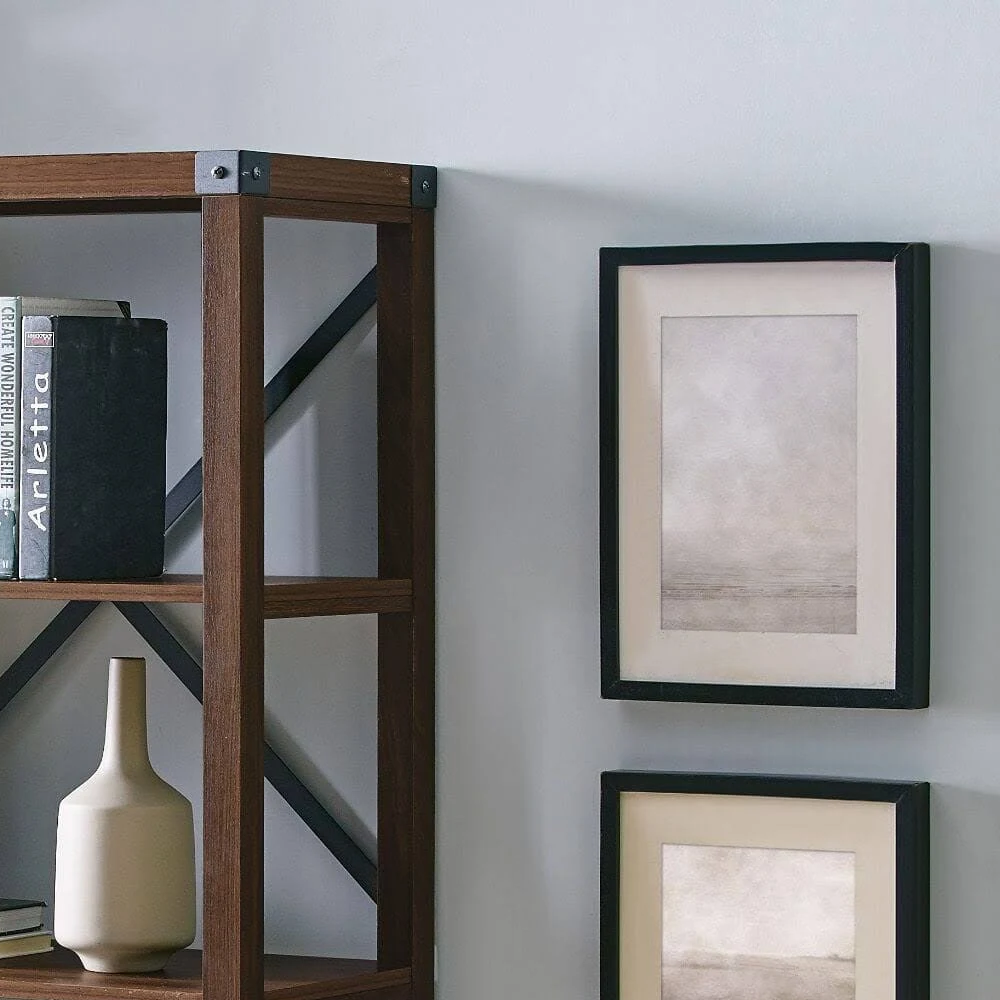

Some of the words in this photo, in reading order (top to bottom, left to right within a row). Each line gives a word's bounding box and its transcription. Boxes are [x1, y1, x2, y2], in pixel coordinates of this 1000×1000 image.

[0, 306, 15, 349] CREATE
[0, 352, 15, 428] WONDERFUL
[0, 430, 15, 490] HOMELIFE
[26, 372, 49, 532] Arletta
